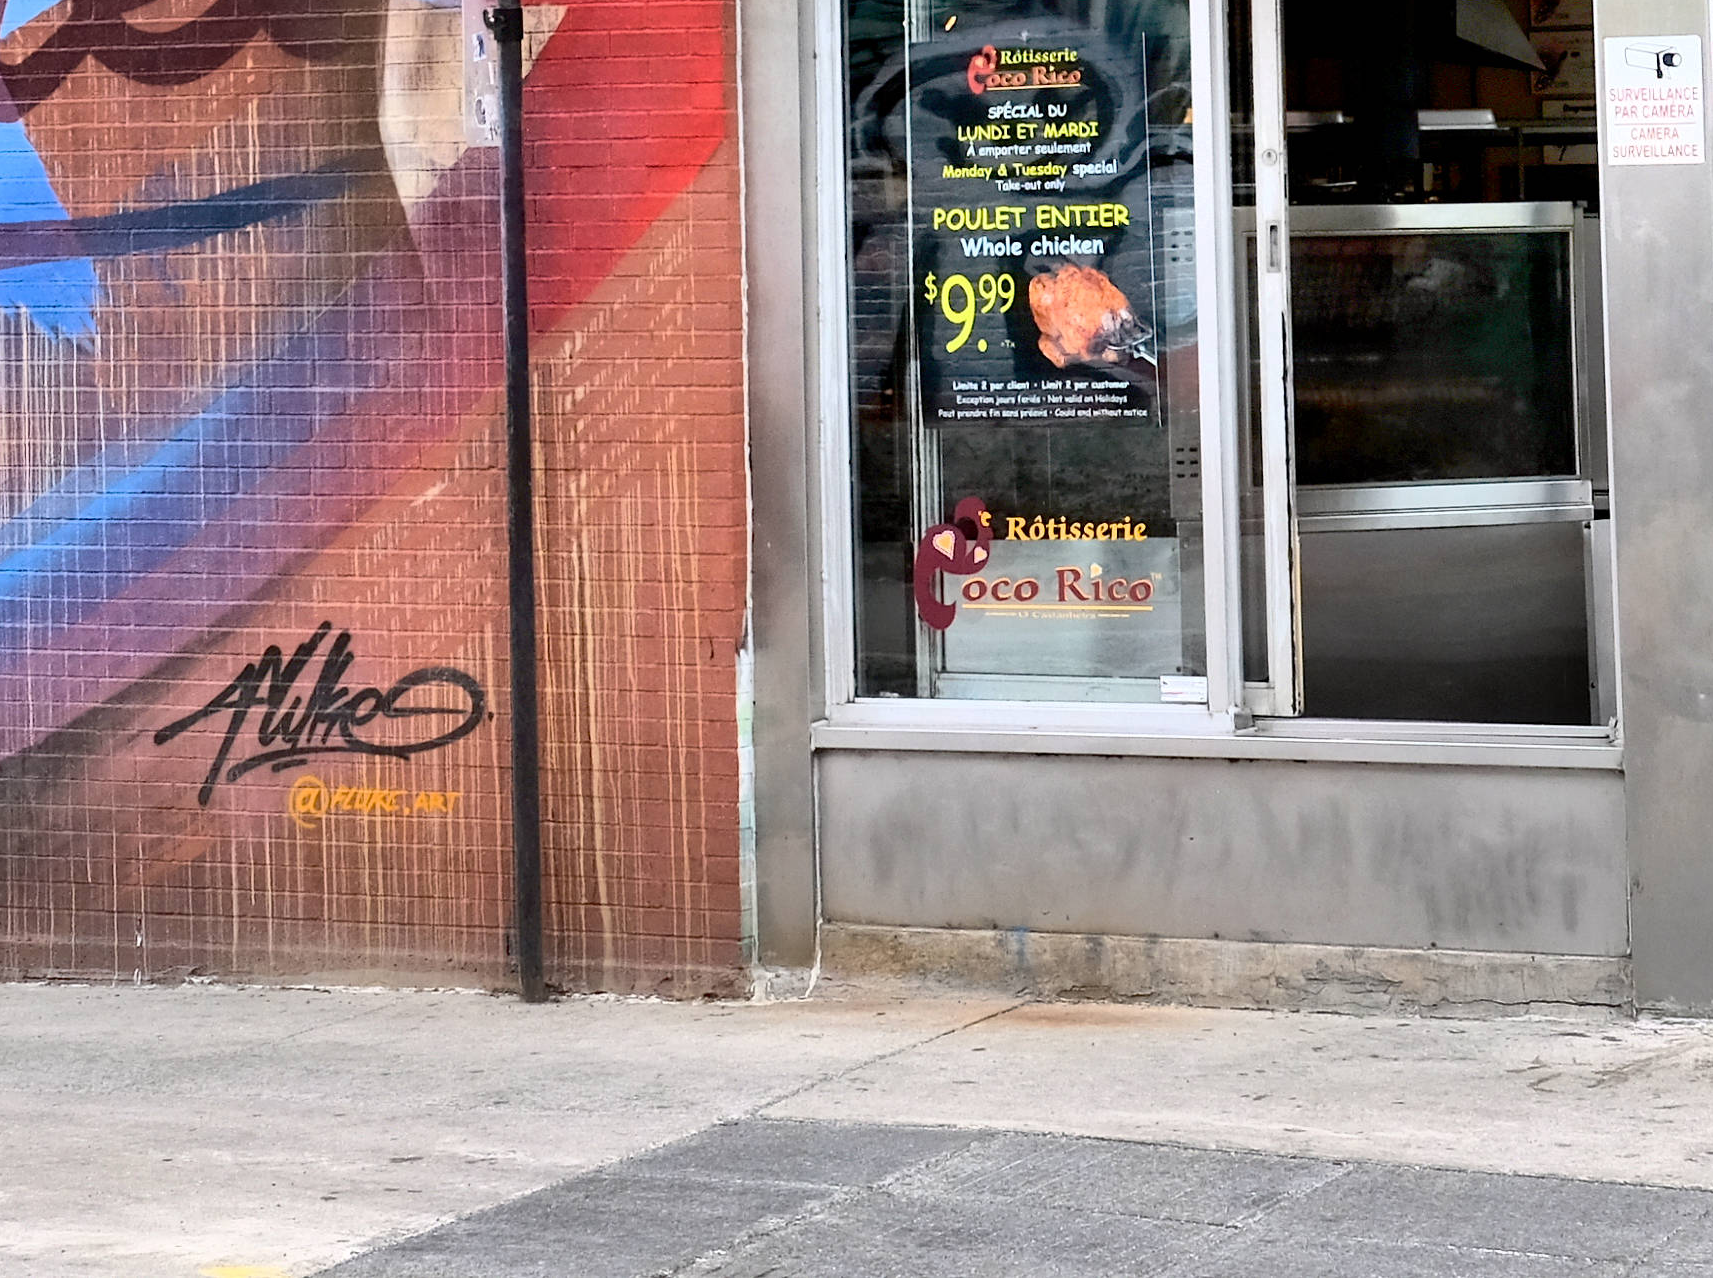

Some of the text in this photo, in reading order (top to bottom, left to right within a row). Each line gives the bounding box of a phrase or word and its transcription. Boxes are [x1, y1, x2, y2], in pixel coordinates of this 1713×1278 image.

[999, 47, 1078, 65] Rôtisserie
[1031, 65, 1082, 85] Rico
[1609, 86, 1699, 102] SURVEILLANCE
[987, 100, 1068, 119] SPÉCIAL DU
[1614, 105, 1638, 118] PAR
[957, 121, 1099, 142] LUNDI ET MARDI
[1630, 127, 1680, 140] CAMERA
[978, 144, 1032, 158] emporter
[1035, 141, 1092, 154] seulement
[1612, 144, 1698, 158] SURVEILLANCE
[942, 159, 1118, 180] Monday & Tuesday special
[1044, 179, 1066, 192] only
[933, 203, 1130, 231] POULET ENTIER
[961, 234, 1105, 258] Whole chicken
[1006, 515, 1148, 541] Rôtisserie
[1055, 563, 1154, 602] Rico
